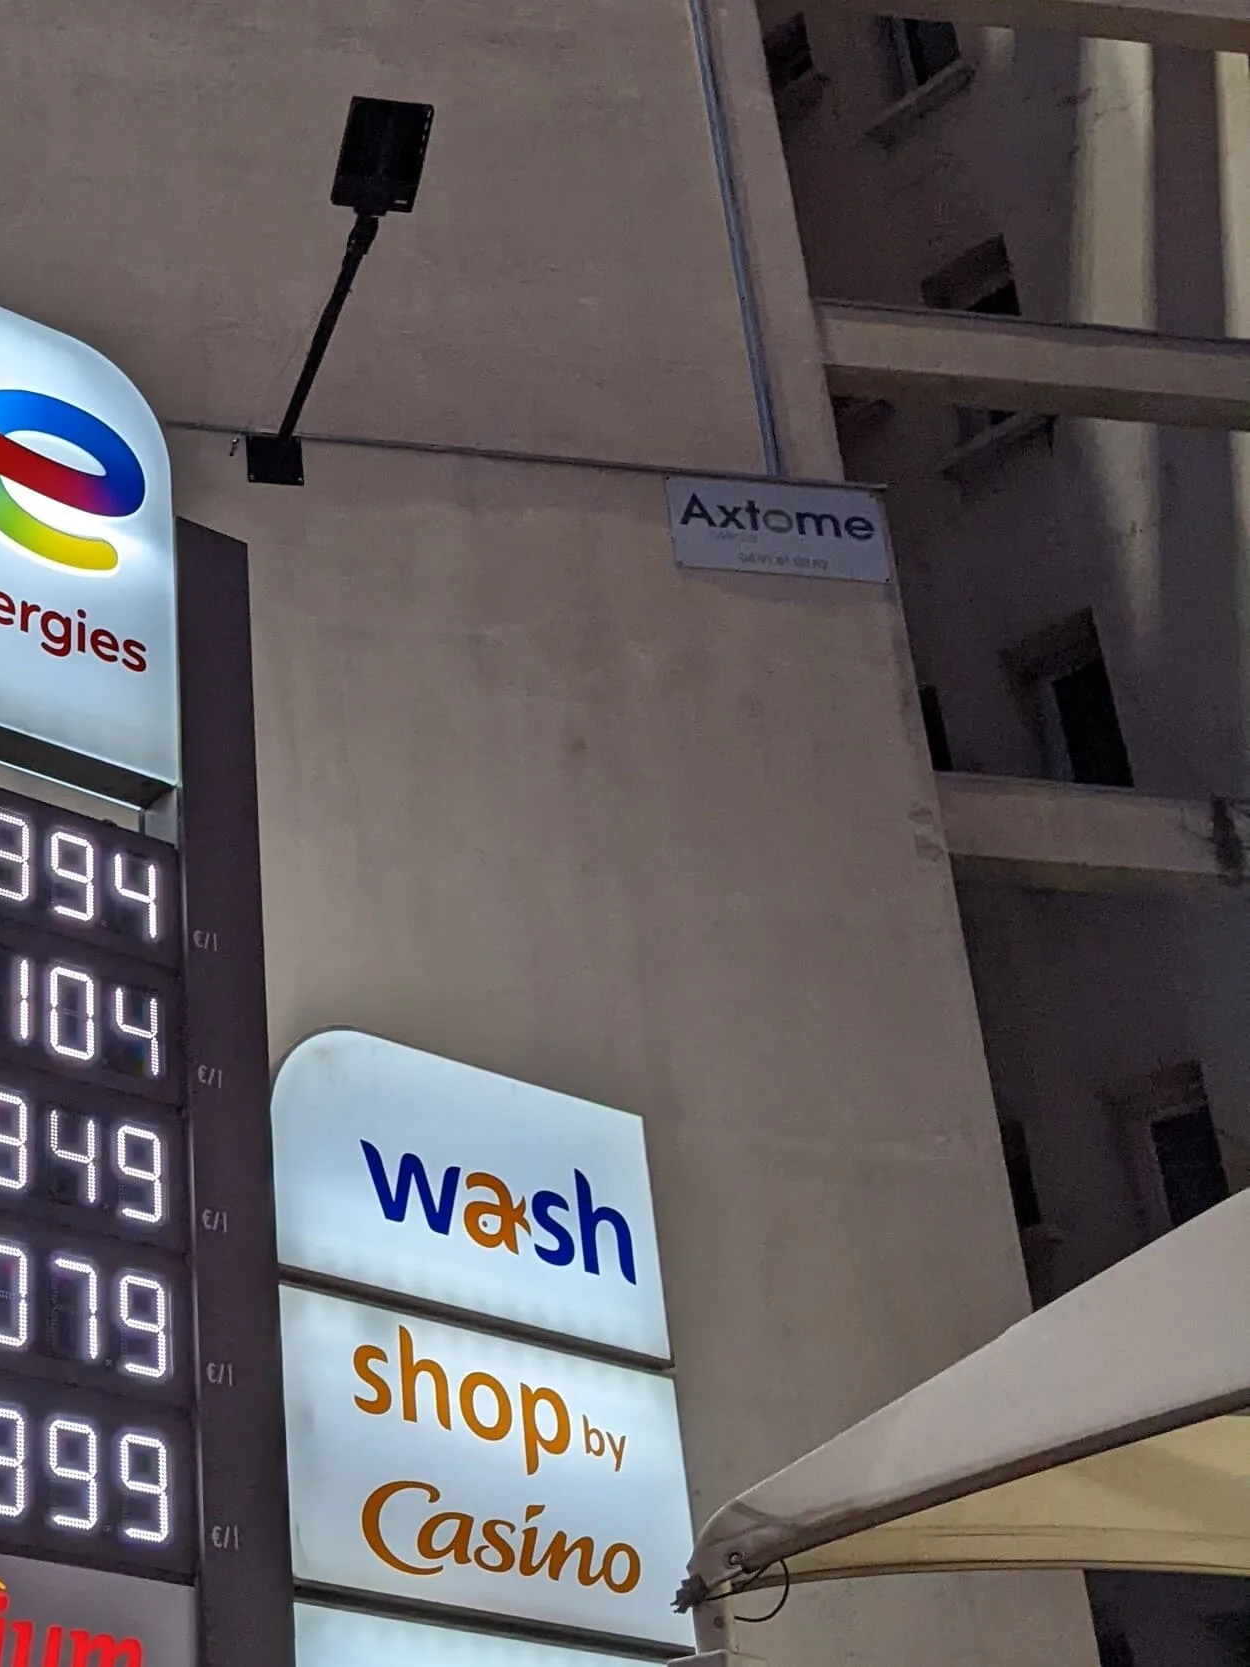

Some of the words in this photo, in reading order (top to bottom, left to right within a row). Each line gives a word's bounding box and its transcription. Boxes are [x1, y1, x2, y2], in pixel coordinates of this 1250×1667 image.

[680, 492, 875, 541] Axtome
[359, 1139, 638, 1286] wash
[352, 1325, 571, 1476] shop
[582, 1414, 628, 1473] by
[360, 1480, 642, 1594] Casino
